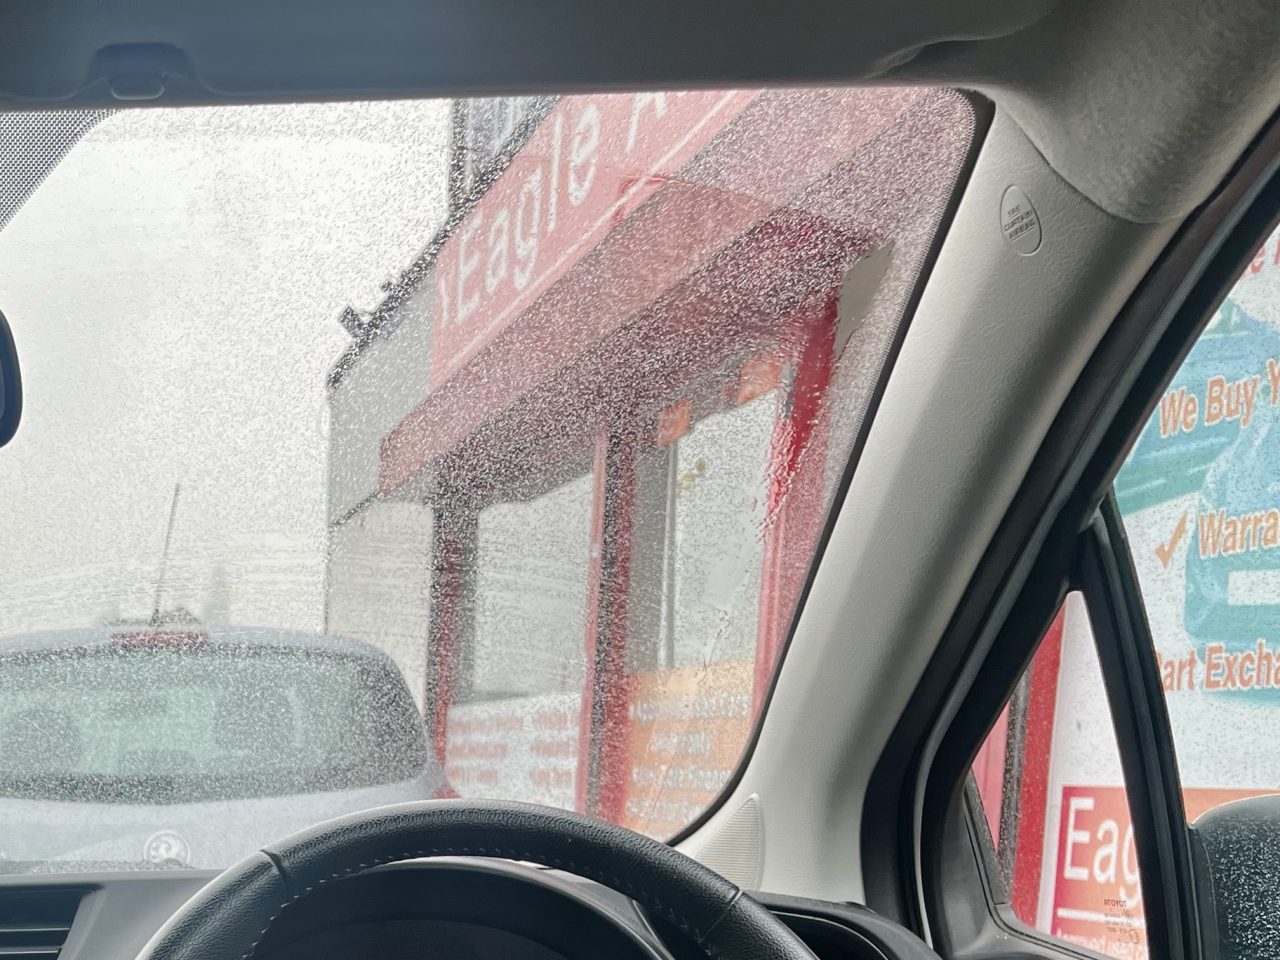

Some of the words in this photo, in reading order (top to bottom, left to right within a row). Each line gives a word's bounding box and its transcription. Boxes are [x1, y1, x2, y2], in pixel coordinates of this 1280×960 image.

[456, 102, 602, 325] Eagle
[1160, 386, 1199, 439] We
[1205, 375, 1260, 429] Buy
